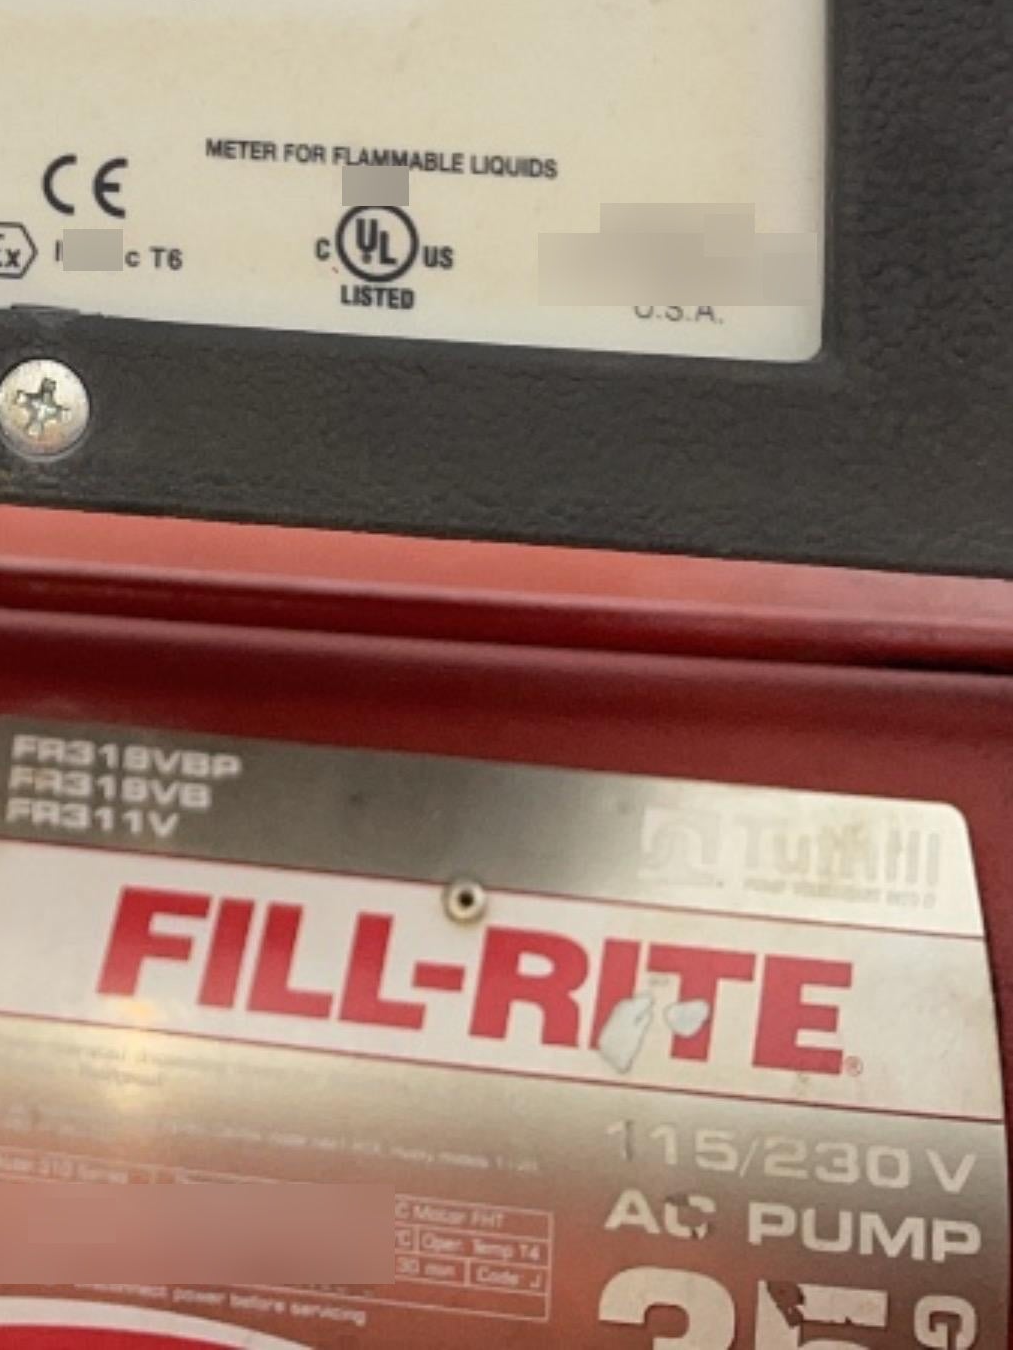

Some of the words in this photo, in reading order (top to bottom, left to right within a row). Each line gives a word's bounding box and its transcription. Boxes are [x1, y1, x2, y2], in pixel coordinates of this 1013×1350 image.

[205, 137, 277, 162] METER
[283, 143, 327, 165] FOR
[332, 146, 465, 175] FLAMMABLE
[470, 154, 559, 180] LIQUIDS
[41, 153, 129, 220] CE
[149, 245, 184, 271] T6
[422, 245, 455, 270] US
[339, 284, 415, 311] LISTED
[96, 884, 854, 1077] FILL-RITE
[604, 1119, 913, 1191] 115/230
[925, 1148, 977, 1195] V
[603, 1188, 718, 1240] AC
[747, 1200, 983, 1265] PUMP
